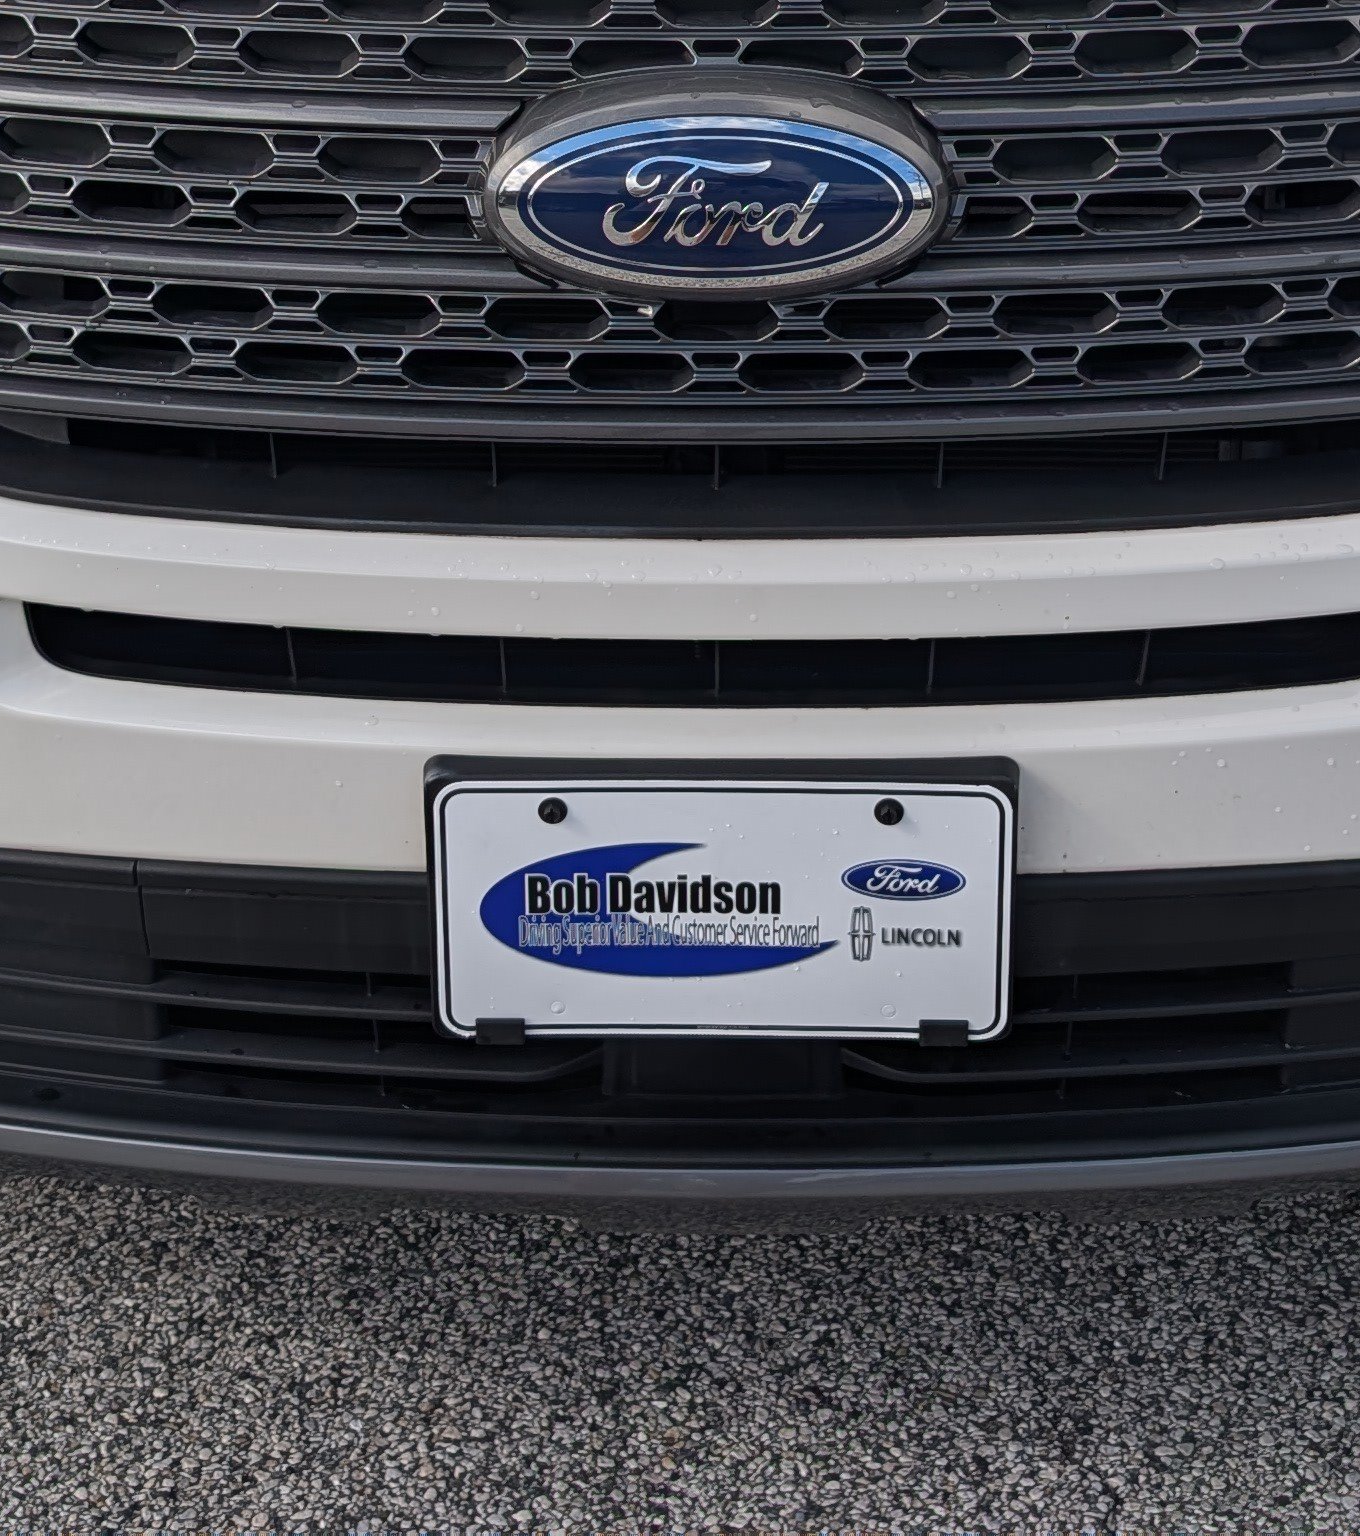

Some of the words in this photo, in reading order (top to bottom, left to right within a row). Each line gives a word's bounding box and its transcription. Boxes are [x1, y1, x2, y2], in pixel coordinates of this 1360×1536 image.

[601, 155, 830, 247] Ford
[526, 874, 599, 914] Bob
[608, 874, 781, 914] Davidson
[866, 865, 941, 894] Ford
[518, 914, 561, 955] Driving
[562, 914, 612, 955] Superior
[611, 913, 646, 946] Value
[646, 913, 671, 946] And
[672, 914, 728, 946] Customer
[729, 915, 770, 946] Service
[772, 915, 820, 947] Forward
[881, 926, 962, 946] LINCOLN
